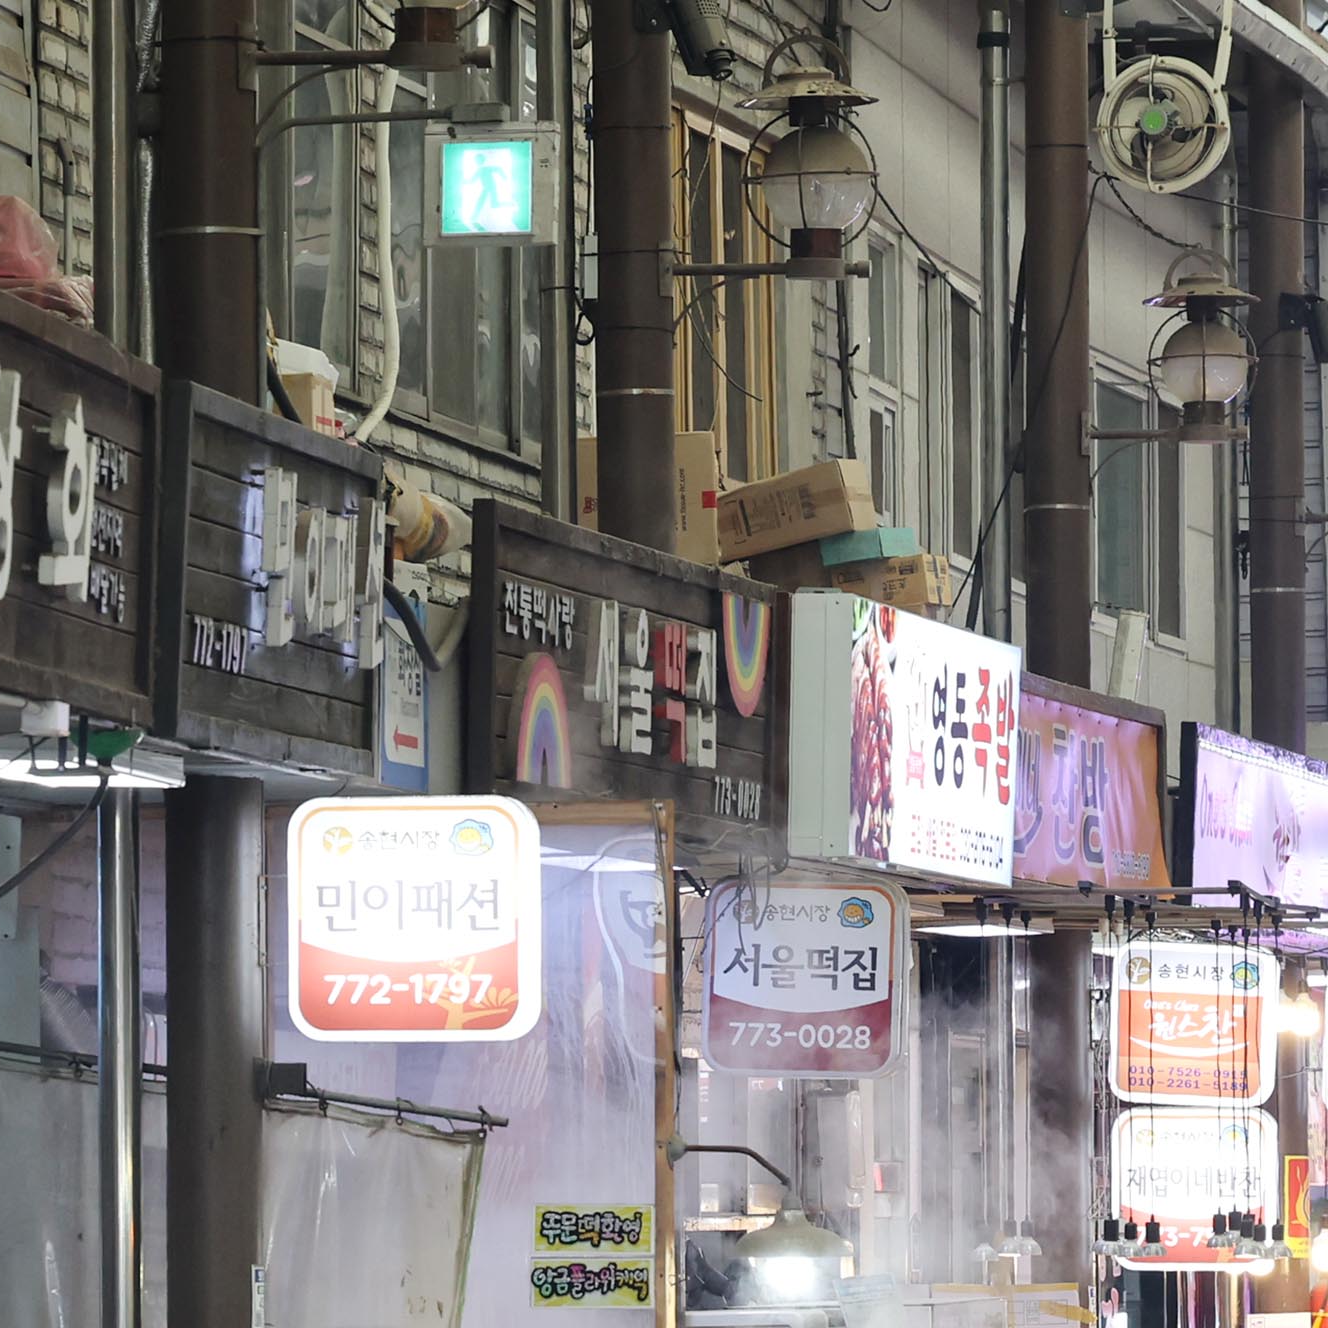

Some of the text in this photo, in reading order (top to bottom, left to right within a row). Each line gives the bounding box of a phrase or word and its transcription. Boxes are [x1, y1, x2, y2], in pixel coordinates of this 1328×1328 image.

[504, 579, 576, 650] 전통떡사랑
[193, 613, 249, 674] 772-1797
[584, 600, 718, 769] 서울떡집
[931, 660, 1016, 805] 영동족발
[714, 776, 761, 821] 773-0028
[358, 828, 440, 853] 송현시장
[316, 878, 501, 933] 민이패션
[760, 900, 831, 925] 송현시장
[323, 971, 495, 1006] 772-1797
[724, 945, 879, 993] 서울떡집
[1158, 963, 1225, 983] 송현시장
[728, 1020, 872, 1051] 773-0028
[1127, 1165, 1261, 1199] 재엽이네반찬
[541, 1210, 644, 1248] 주문떡환영
